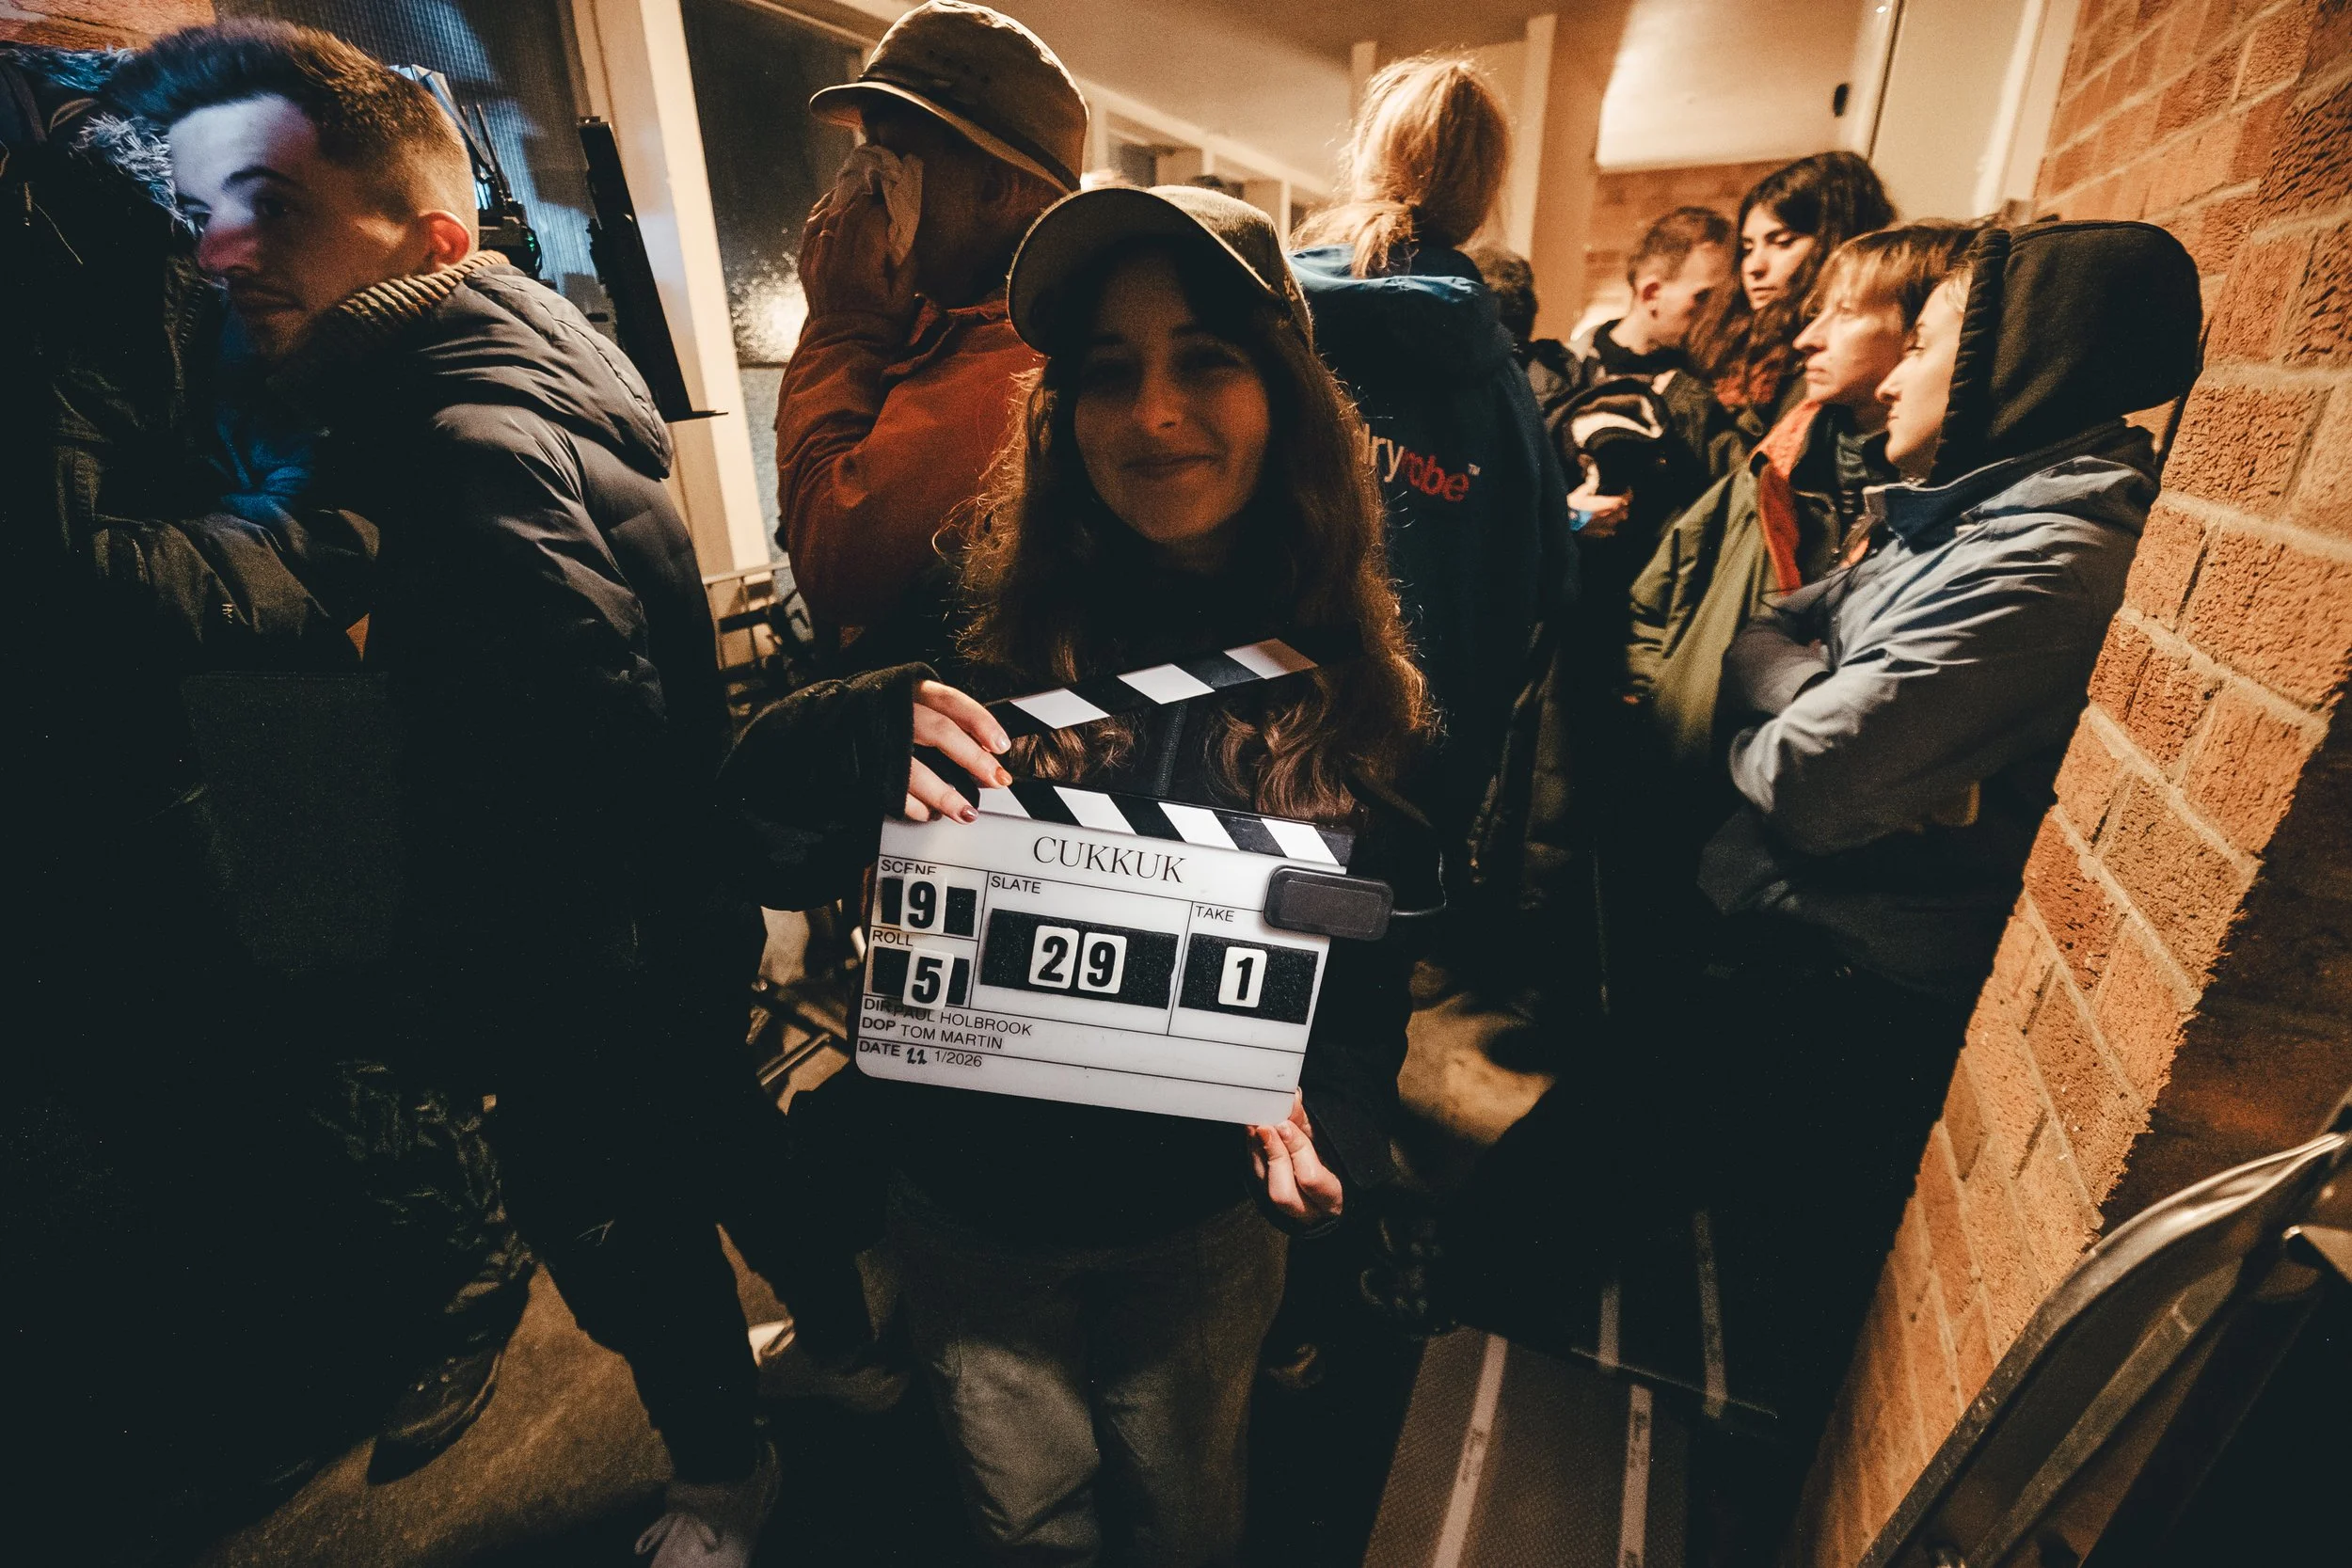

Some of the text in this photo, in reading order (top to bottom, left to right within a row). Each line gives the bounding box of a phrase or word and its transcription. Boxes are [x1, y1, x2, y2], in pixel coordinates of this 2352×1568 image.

[1033, 835, 1187, 883] CUKKUK
[991, 876, 1041, 895] SLATE
[908, 880, 937, 929] 9
[1196, 906, 1235, 923] TAKE
[872, 929, 914, 946] ROLL
[1037, 935, 1118, 988] 29
[912, 956, 942, 1005] 5
[1236, 957, 1254, 1001] 1
[863, 1016, 1003, 1050] DOP TOM MARTIN
[941, 1011, 1032, 1036] HOLBROOK
[859, 1039, 901, 1057] DATE
[934, 1051, 983, 1068] 1/2026
